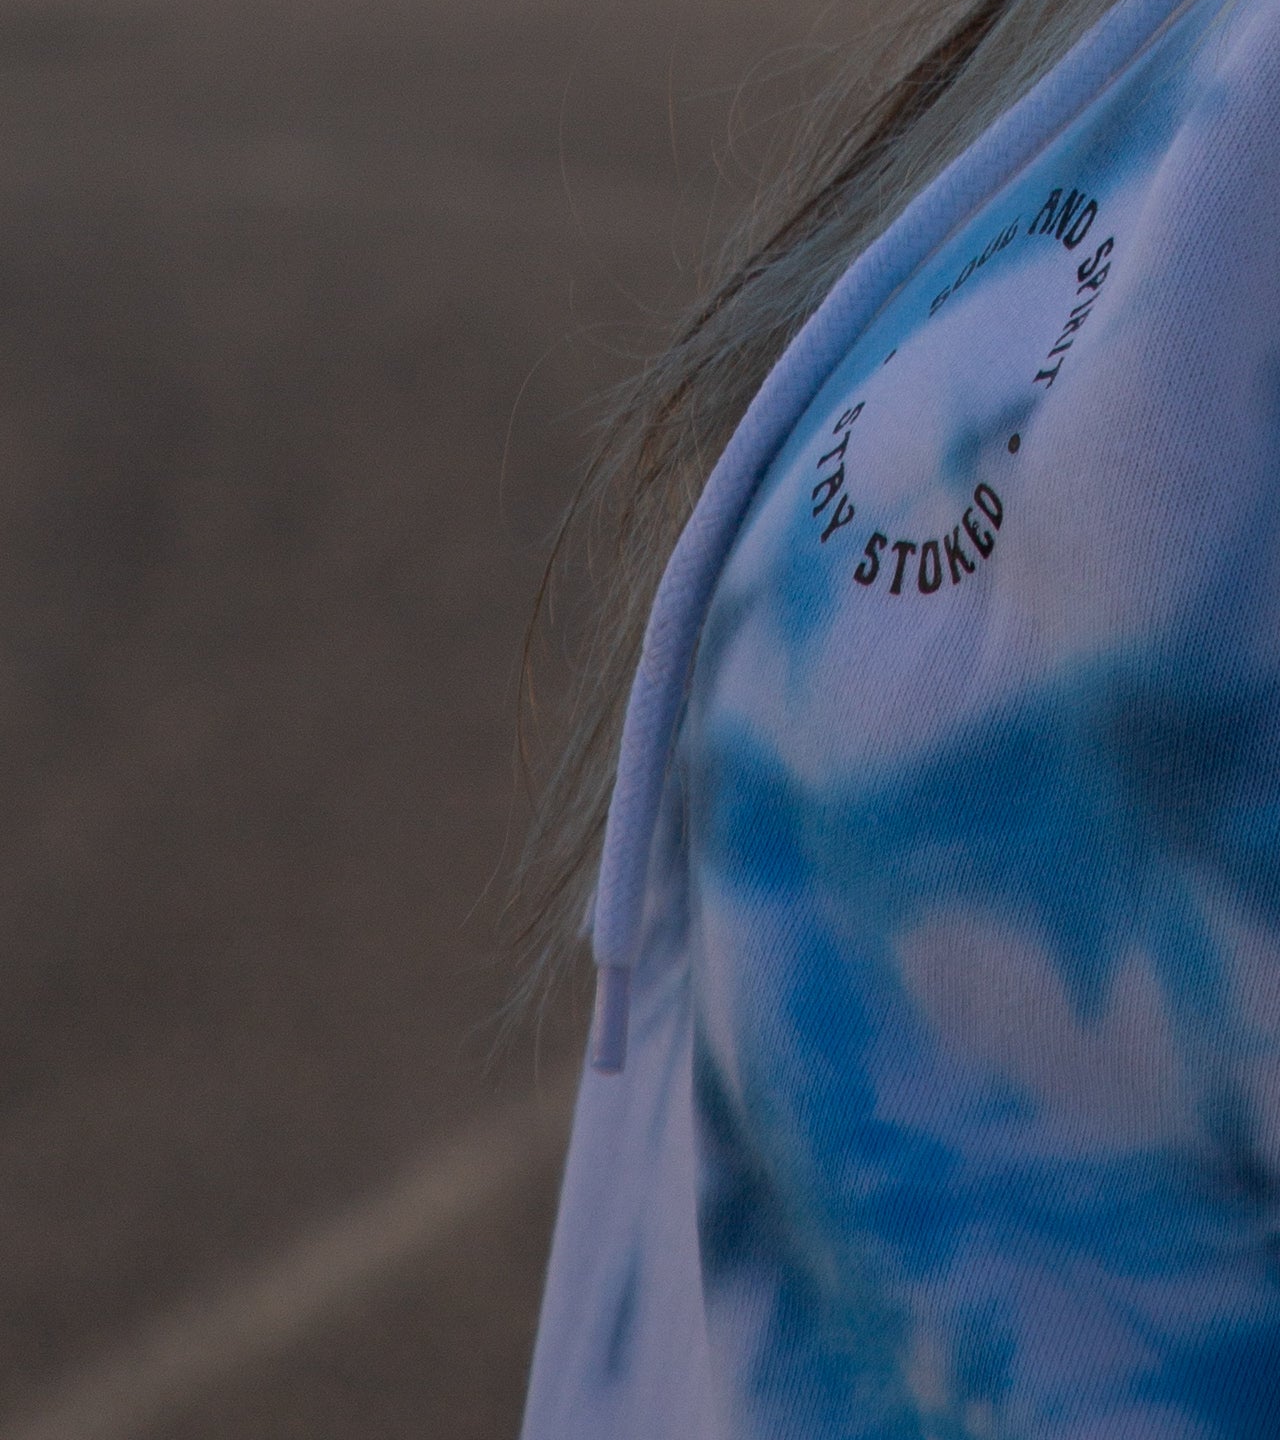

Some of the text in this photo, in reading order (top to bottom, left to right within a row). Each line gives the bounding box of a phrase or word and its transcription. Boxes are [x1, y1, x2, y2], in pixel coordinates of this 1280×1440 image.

[1027, 188, 1098, 250] AND
[1032, 236, 1114, 389] SPIRIT
[812, 400, 1003, 595] STAY STOKED
